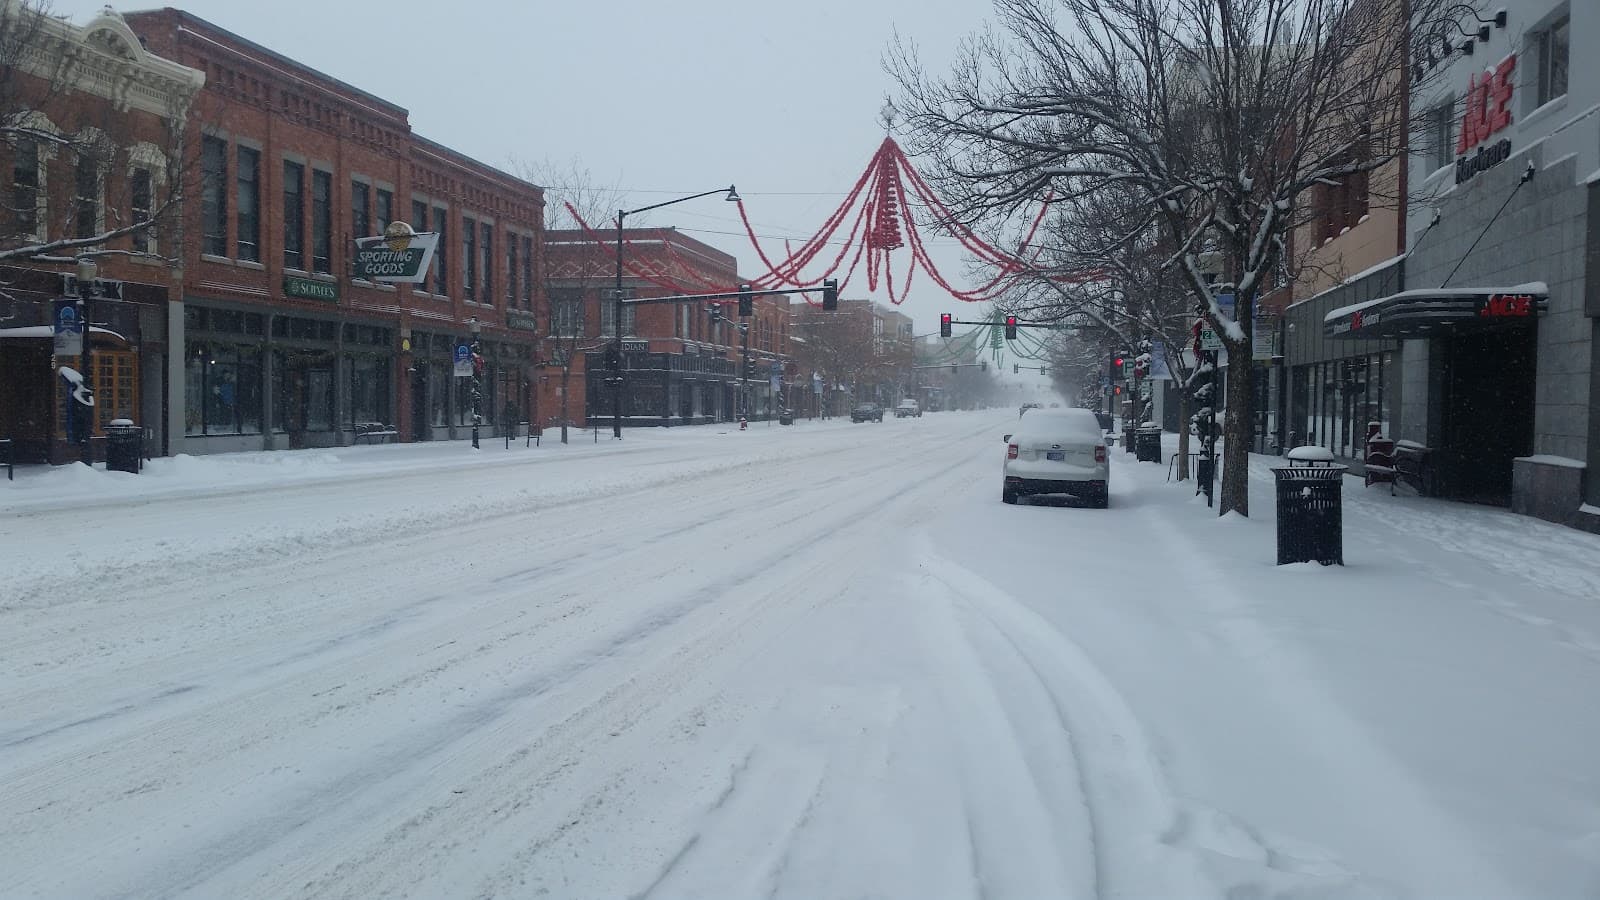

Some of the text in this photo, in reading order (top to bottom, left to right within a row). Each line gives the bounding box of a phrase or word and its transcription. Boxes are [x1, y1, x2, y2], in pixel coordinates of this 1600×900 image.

[1456, 54, 1517, 156] ACE
[1456, 137, 1512, 185] Hardware
[359, 251, 412, 263] SPORTING
[365, 263, 404, 274] GOODS
[1124, 361, 1135, 374] P
